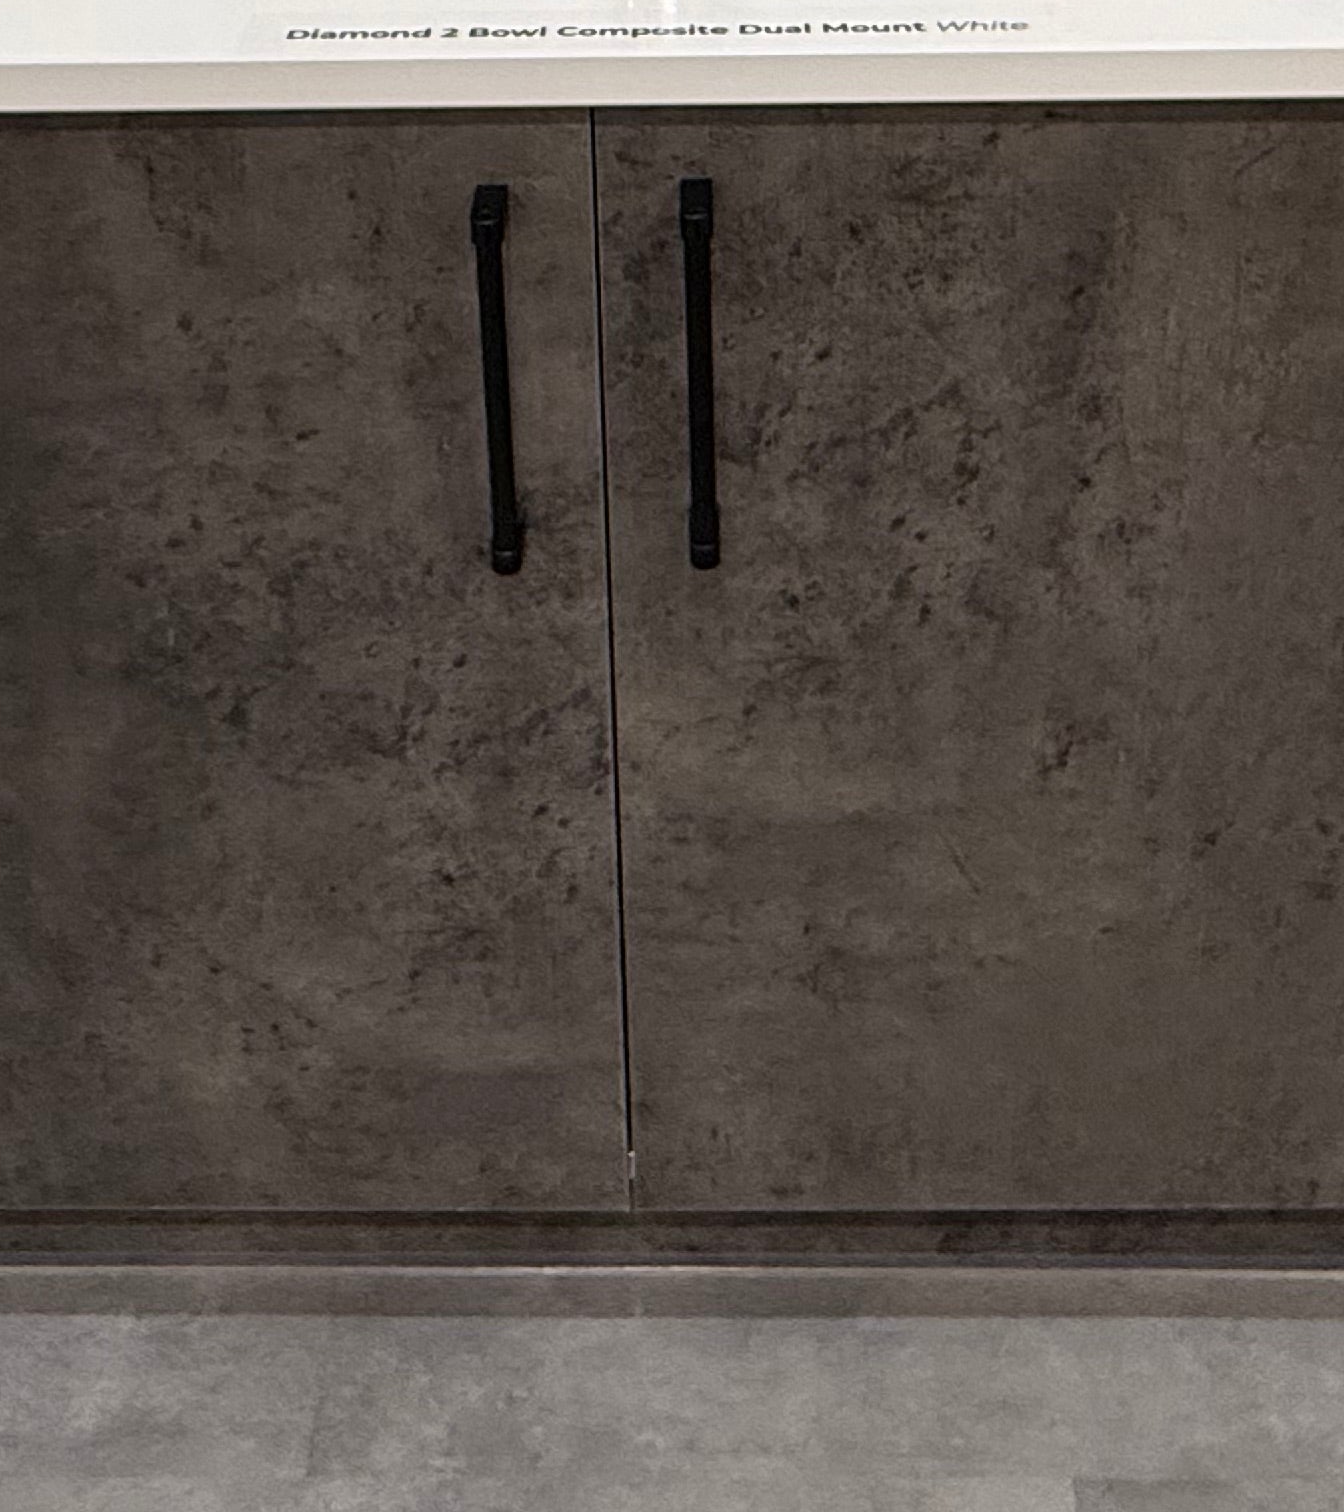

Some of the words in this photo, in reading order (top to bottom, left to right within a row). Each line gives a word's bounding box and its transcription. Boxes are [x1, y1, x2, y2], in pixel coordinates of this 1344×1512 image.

[286, 27, 432, 40] Diamond
[439, 27, 460, 39] 2
[468, 26, 547, 39] Bowl
[556, 25, 730, 39] Composite
[738, 22, 812, 35] Dual
[822, 21, 928, 34] Mount
[936, 20, 1030, 33] White
